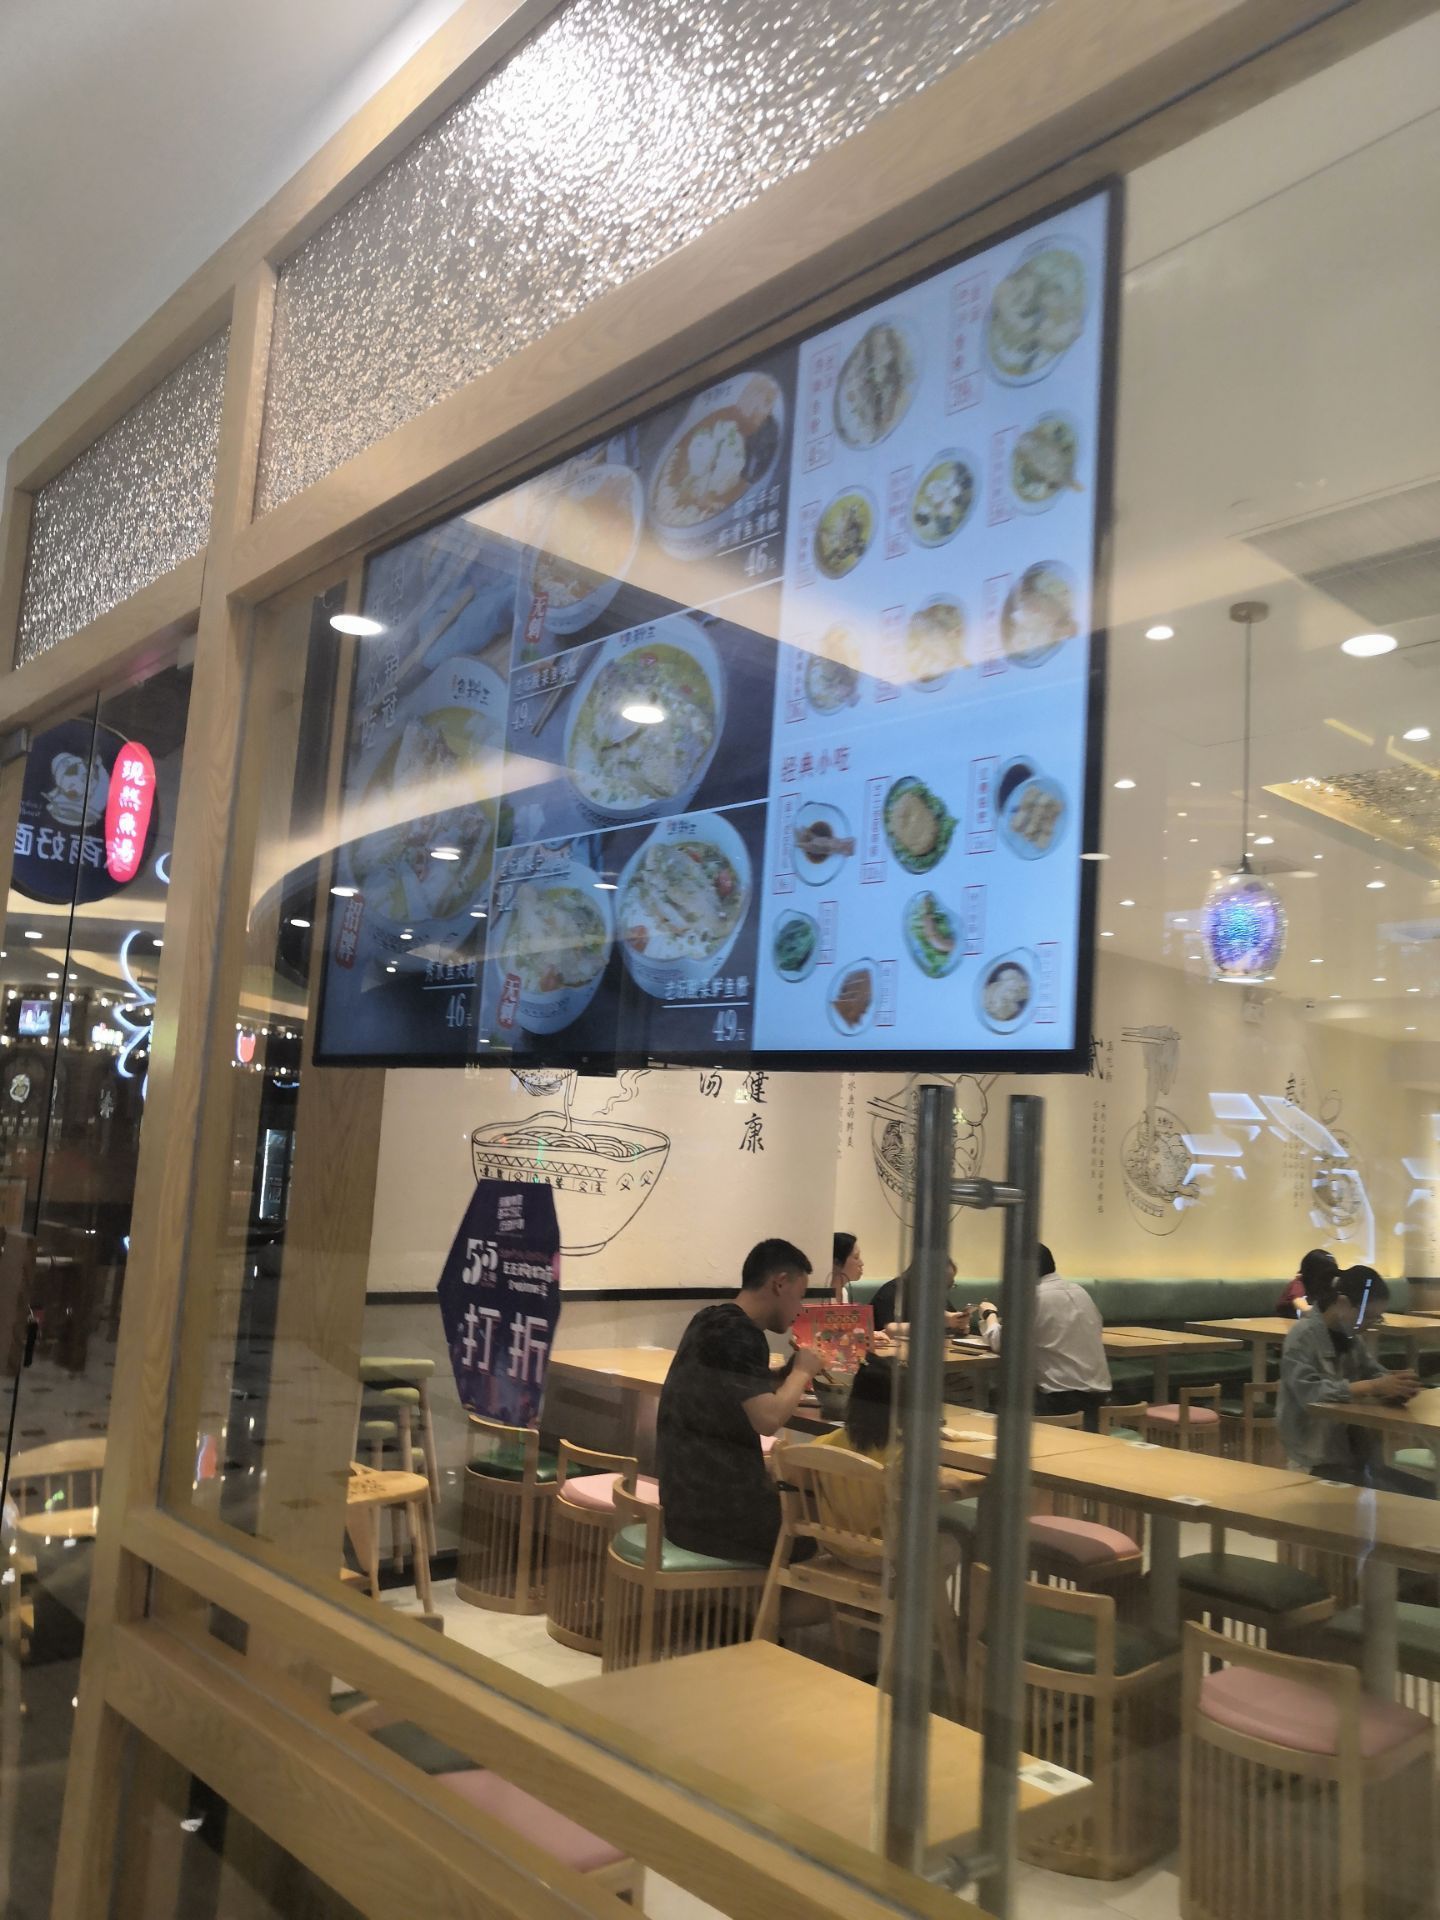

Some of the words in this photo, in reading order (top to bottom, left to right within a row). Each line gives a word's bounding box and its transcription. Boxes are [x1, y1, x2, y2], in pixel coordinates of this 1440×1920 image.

[780, 747, 851, 782] 经典小吃
[700, 1070, 723, 1098] 汤
[738, 1069, 770, 1154] 健康
[461, 1303, 549, 1385] 打折
